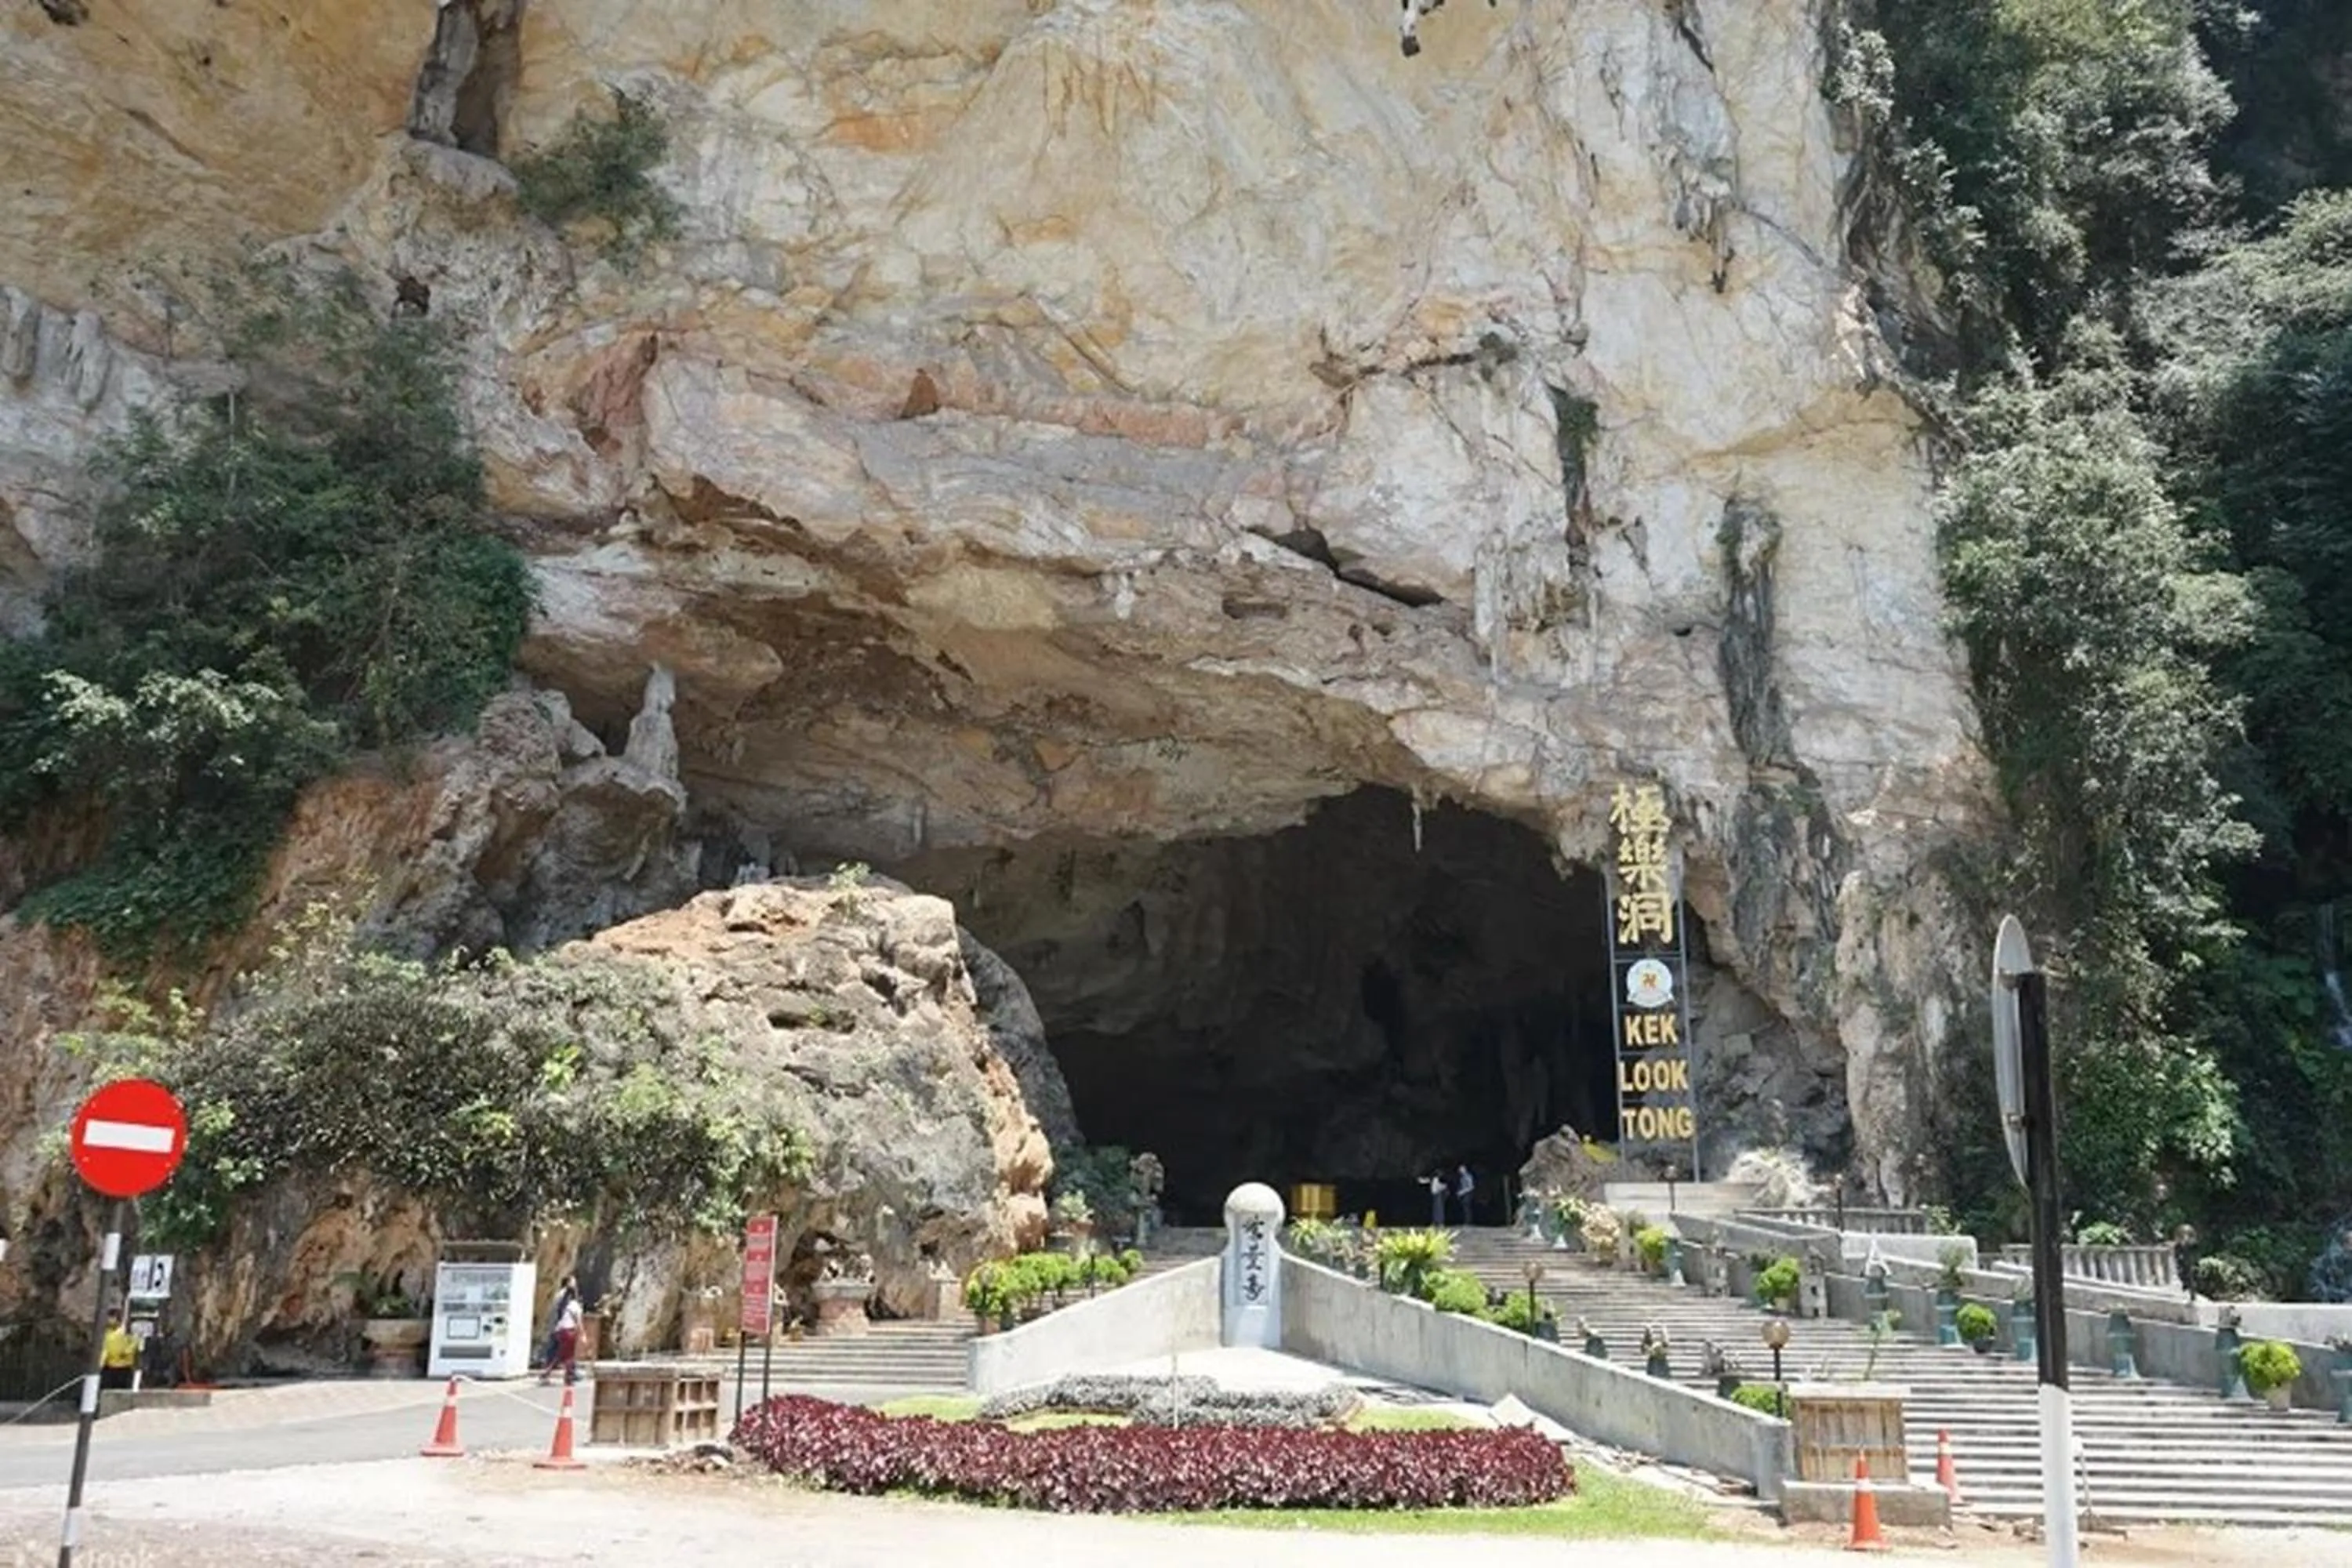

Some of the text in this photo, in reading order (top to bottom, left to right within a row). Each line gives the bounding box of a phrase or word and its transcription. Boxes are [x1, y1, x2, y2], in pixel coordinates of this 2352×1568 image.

[1624, 1014, 1679, 1047] KEK
[1619, 1059, 1689, 1091] LOOK
[1621, 1106, 1695, 1139] TONG
